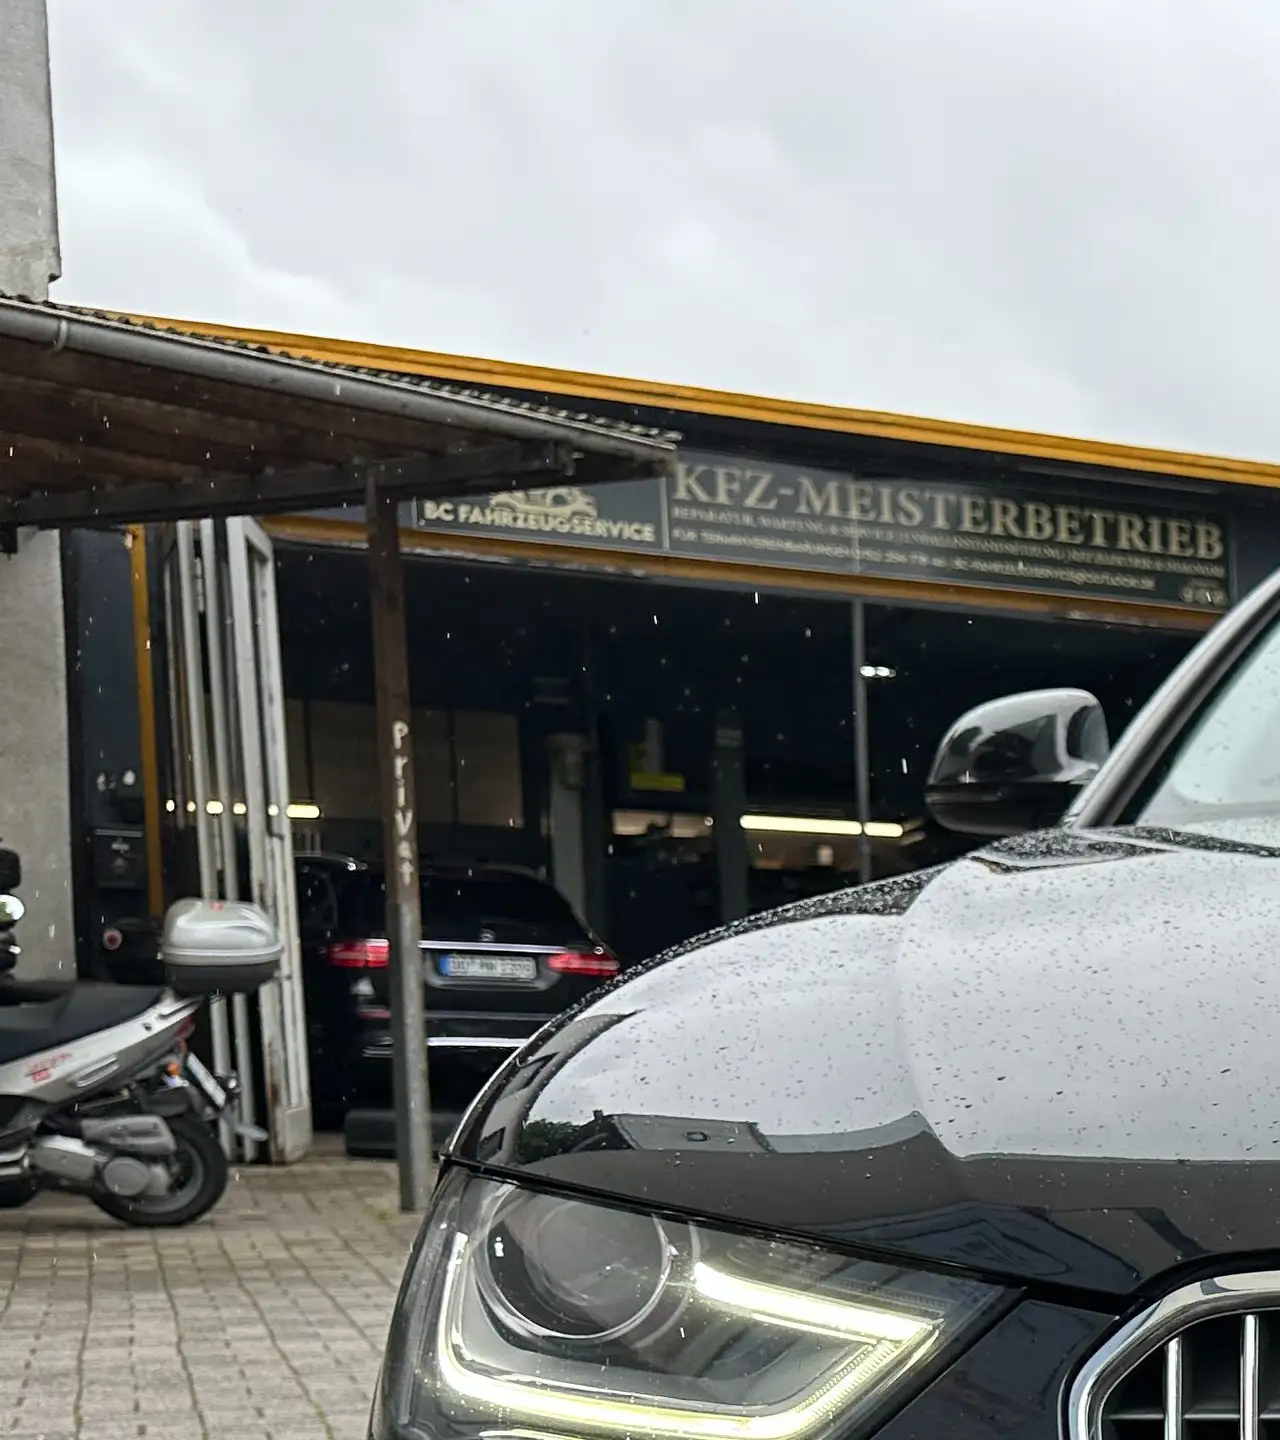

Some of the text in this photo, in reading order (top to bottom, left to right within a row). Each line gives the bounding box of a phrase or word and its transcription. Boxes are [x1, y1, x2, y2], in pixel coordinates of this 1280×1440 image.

[422, 499, 657, 543] BC FAHRZEUGSERVICE
[673, 462, 1225, 561] KFZ-MEISTERBETRIEB
